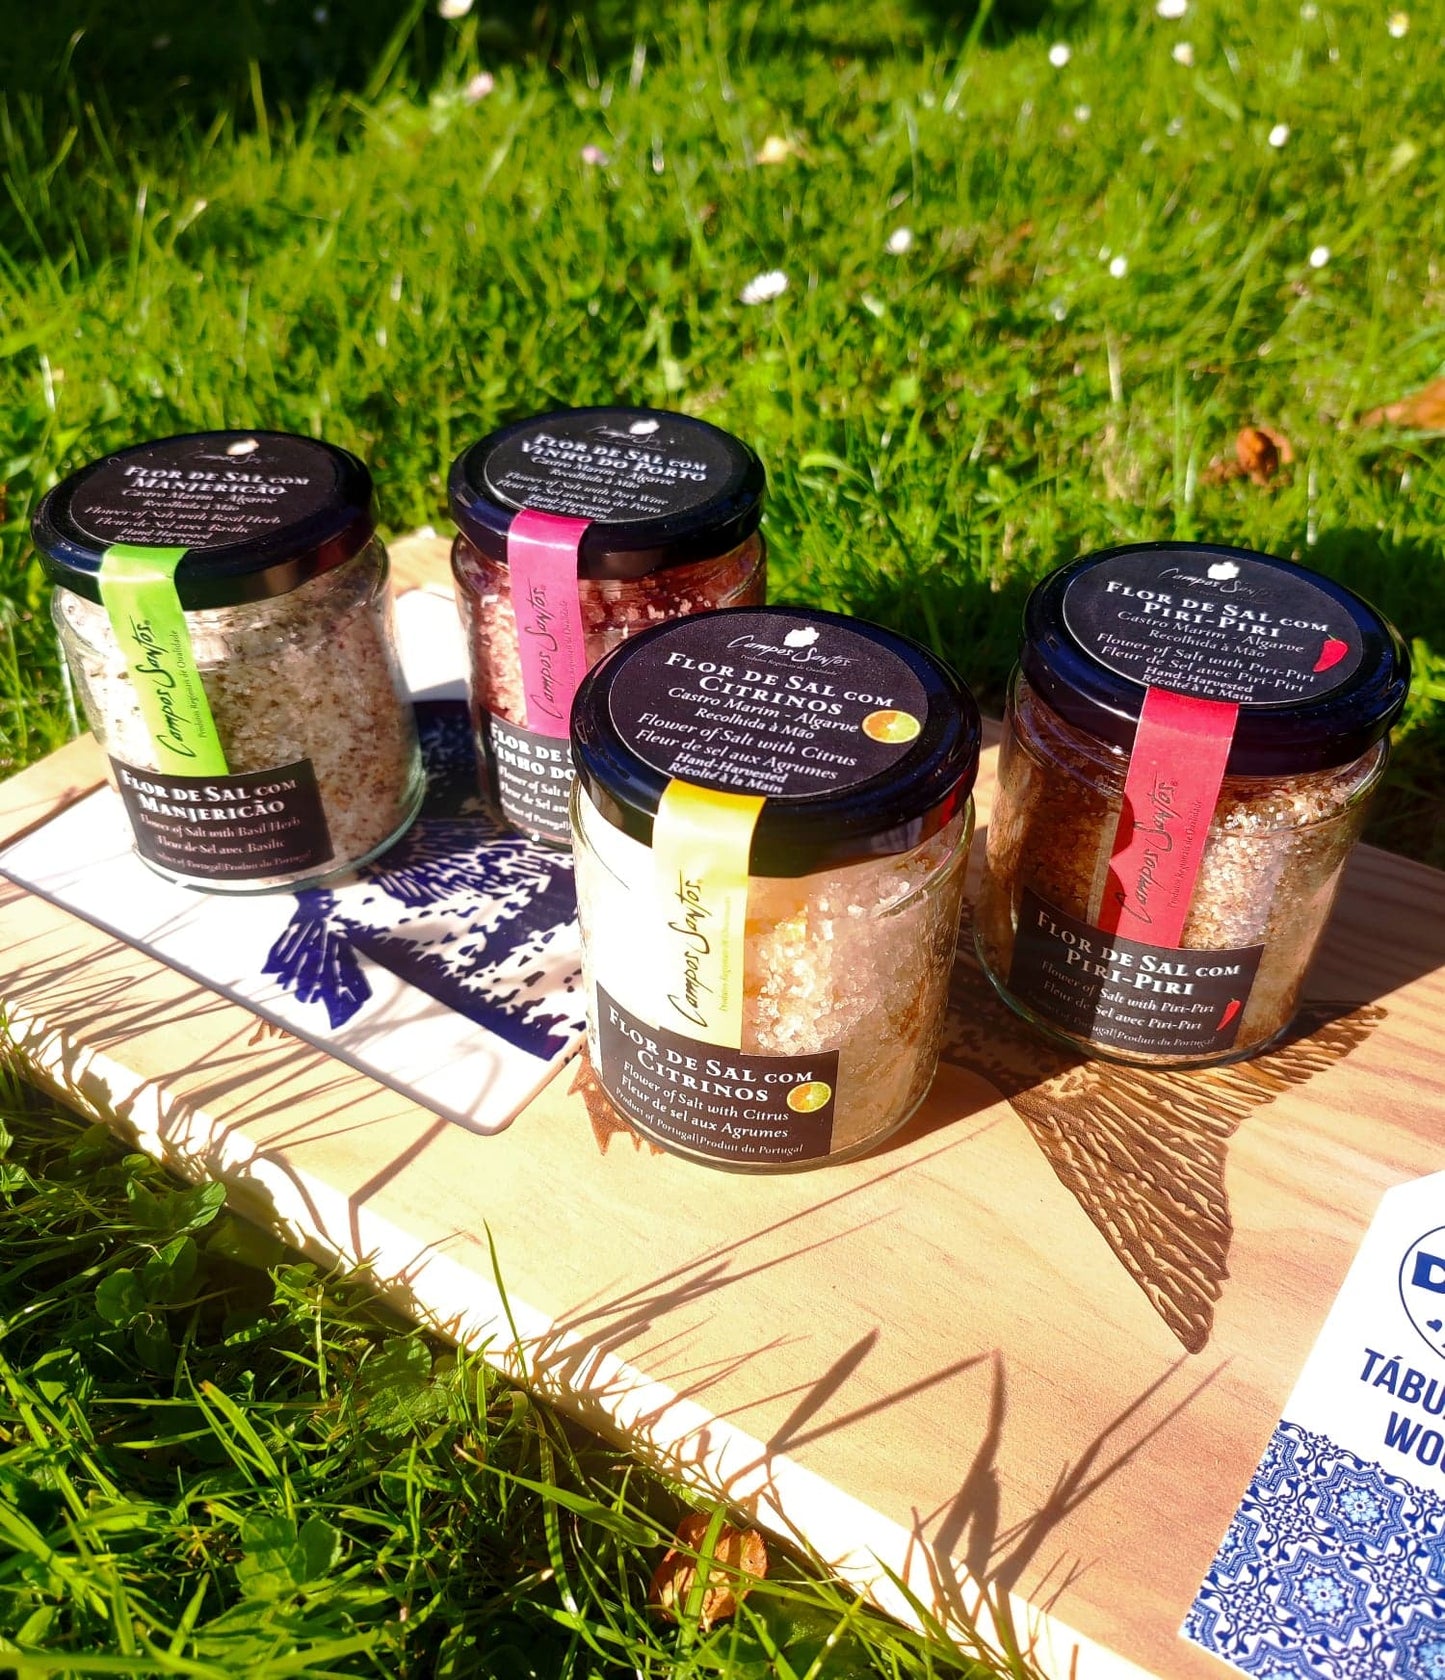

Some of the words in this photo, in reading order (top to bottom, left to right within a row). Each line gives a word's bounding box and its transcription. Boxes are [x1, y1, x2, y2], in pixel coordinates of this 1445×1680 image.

[124, 466, 183, 480] FLOR
[189, 470, 218, 481] DE
[224, 471, 264, 484] SAL
[269, 477, 310, 486] COM
[130, 477, 288, 495] MANJERICÃO
[1158, 567, 1221, 590] Campos
[524, 577, 558, 652] Santos
[1105, 581, 1172, 604] FLOR
[1181, 598, 1215, 613] DE
[1222, 604, 1272, 623] SAL
[1279, 618, 1328, 632] COM
[1117, 610, 1169, 629] Castro
[1172, 622, 1226, 640] Marim
[1241, 636, 1305, 654] Algarve
[1142, 602, 1280, 638] PIRI-PIRI
[129, 615, 177, 688] Santos
[727, 634, 795, 658] Campos
[791, 646, 860, 667] Santos
[1096, 632, 1150, 651] Flower
[1153, 644, 1168, 659] of
[1175, 648, 1204, 662] Salt
[1208, 654, 1245, 669] with
[1249, 662, 1316, 683] Piri-Piri
[1100, 645, 1143, 662] Fleur
[1145, 654, 1165, 666] de
[1170, 657, 1193, 671] Sel
[1196, 666, 1233, 678] avec
[1236, 671, 1305, 693] Piri-Piri
[1148, 629, 1218, 649] Recolhida
[1220, 642, 1231, 652] à
[1233, 645, 1266, 658] Mão
[530, 651, 564, 720] Campos
[665, 652, 734, 677] FLOR
[743, 670, 778, 685] DE
[784, 676, 836, 697] SAL
[842, 691, 895, 707] COM
[699, 676, 844, 716] CITRINOS
[1141, 674, 1191, 691] Récolté
[1191, 683, 1200, 693] à
[1201, 684, 1215, 695] la
[1217, 687, 1254, 701] Main
[1144, 665, 1254, 694] Hand-Harvested
[156, 688, 197, 758] Campos
[667, 687, 720, 706] Castro
[724, 699, 779, 718] Marim
[794, 711, 859, 734] Algarve
[694, 707, 765, 731] Recolhida
[769, 720, 779, 732] à
[780, 724, 815, 740] Mão
[635, 729, 679, 746] Fleur
[681, 738, 701, 752] de
[703, 743, 727, 757] sel
[729, 750, 761, 765] aux
[763, 756, 838, 781] Agrumes
[637, 713, 698, 734] Flower
[700, 726, 720, 741] of
[720, 728, 754, 745] Salt
[757, 738, 796, 755] with
[800, 746, 858, 767] Citrus
[668, 763, 718, 781] Récolté
[719, 772, 728, 783] à
[729, 773, 743, 786] la
[746, 777, 783, 794] Main
[675, 752, 788, 783] Hand-Harvested
[667, 869, 712, 955] Santos
[1037, 910, 1092, 954] FLOR
[1100, 947, 1133, 967] DE
[1139, 955, 1189, 976] SAL
[1194, 964, 1242, 978] COM
[667, 951, 714, 1028] Campos
[1040, 960, 1080, 987] Flower
[1081, 981, 1097, 998] of
[1100, 987, 1126, 1005] Salt
[1127, 998, 1158, 1013] with
[1160, 1002, 1216, 1015] Piri-Piri
[1065, 949, 1195, 996] PIRI-PIRI
[1043, 981, 1073, 1004] Fleur
[1075, 996, 1092, 1009] de
[1094, 1004, 1114, 1020] Sel
[1115, 1014, 1146, 1027] avec
[1148, 1017, 1202, 1030] Piri-Piri
[608, 1004, 659, 1055] FLOR
[665, 1047, 699, 1071] DE
[705, 1059, 757, 1083] SAL
[763, 1071, 813, 1084] COM
[1157, 1037, 1172, 1046] du
[1173, 1037, 1217, 1048] Portugal
[623, 1061, 661, 1092] Flower
[663, 1087, 678, 1105] of
[678, 1093, 703, 1111] Salt
[707, 1104, 738, 1118] with
[743, 1109, 790, 1122] Citrus
[636, 1050, 769, 1102] CITRINOS
[615, 1086, 645, 1116] Product
[645, 1112, 655, 1126] of
[741, 1144, 756, 1154] du
[758, 1144, 804, 1157] Portugal
[621, 1075, 651, 1105] Fleur
[652, 1097, 668, 1113] de
[670, 1106, 689, 1122] sel
[691, 1116, 718, 1131] aux
[720, 1122, 788, 1139] Agrumes
[1360, 1347, 1445, 1416] TÁBU
[1384, 1410, 1445, 1475] WO
